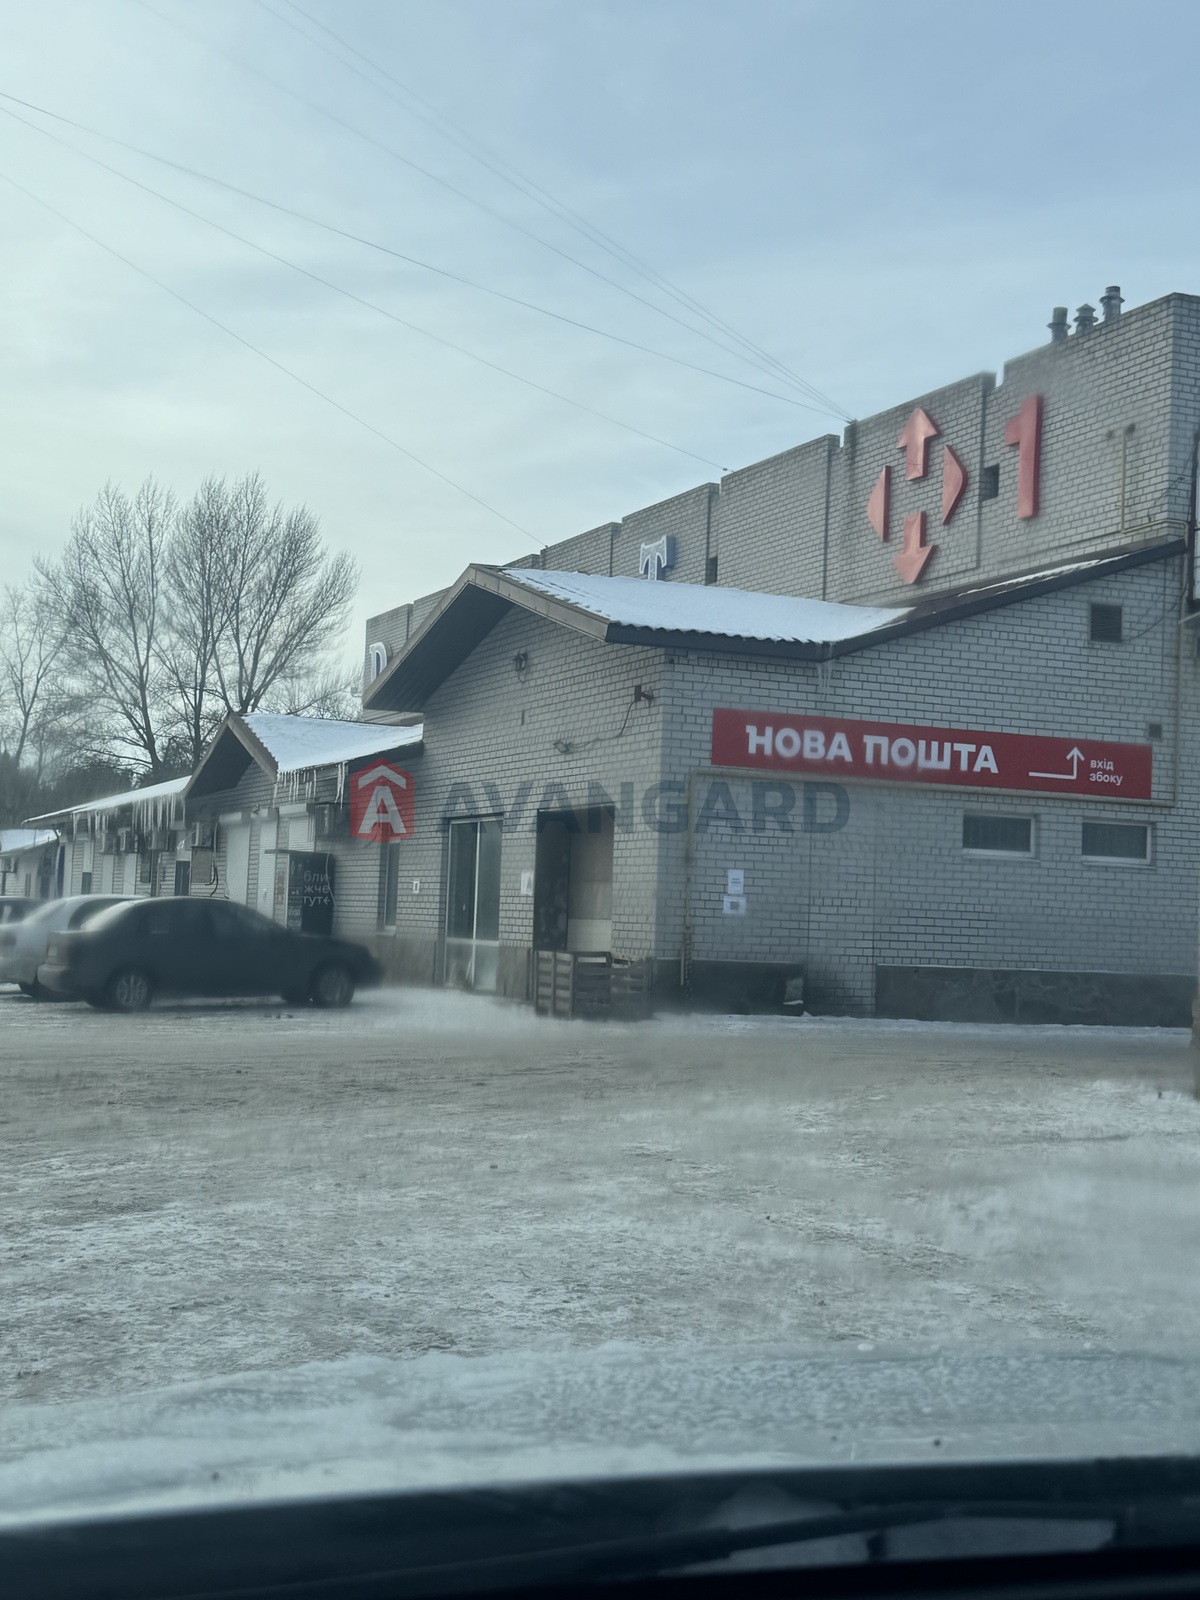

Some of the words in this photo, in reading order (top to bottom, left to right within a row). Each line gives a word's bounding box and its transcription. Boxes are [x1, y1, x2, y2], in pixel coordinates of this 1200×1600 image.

[1004, 394, 1043, 520] 1
[746, 725, 853, 763] НОВА
[863, 734, 999, 774] ПОШТА
[1090, 758, 1114, 771] вхід
[1089, 771, 1123, 786] збоку
